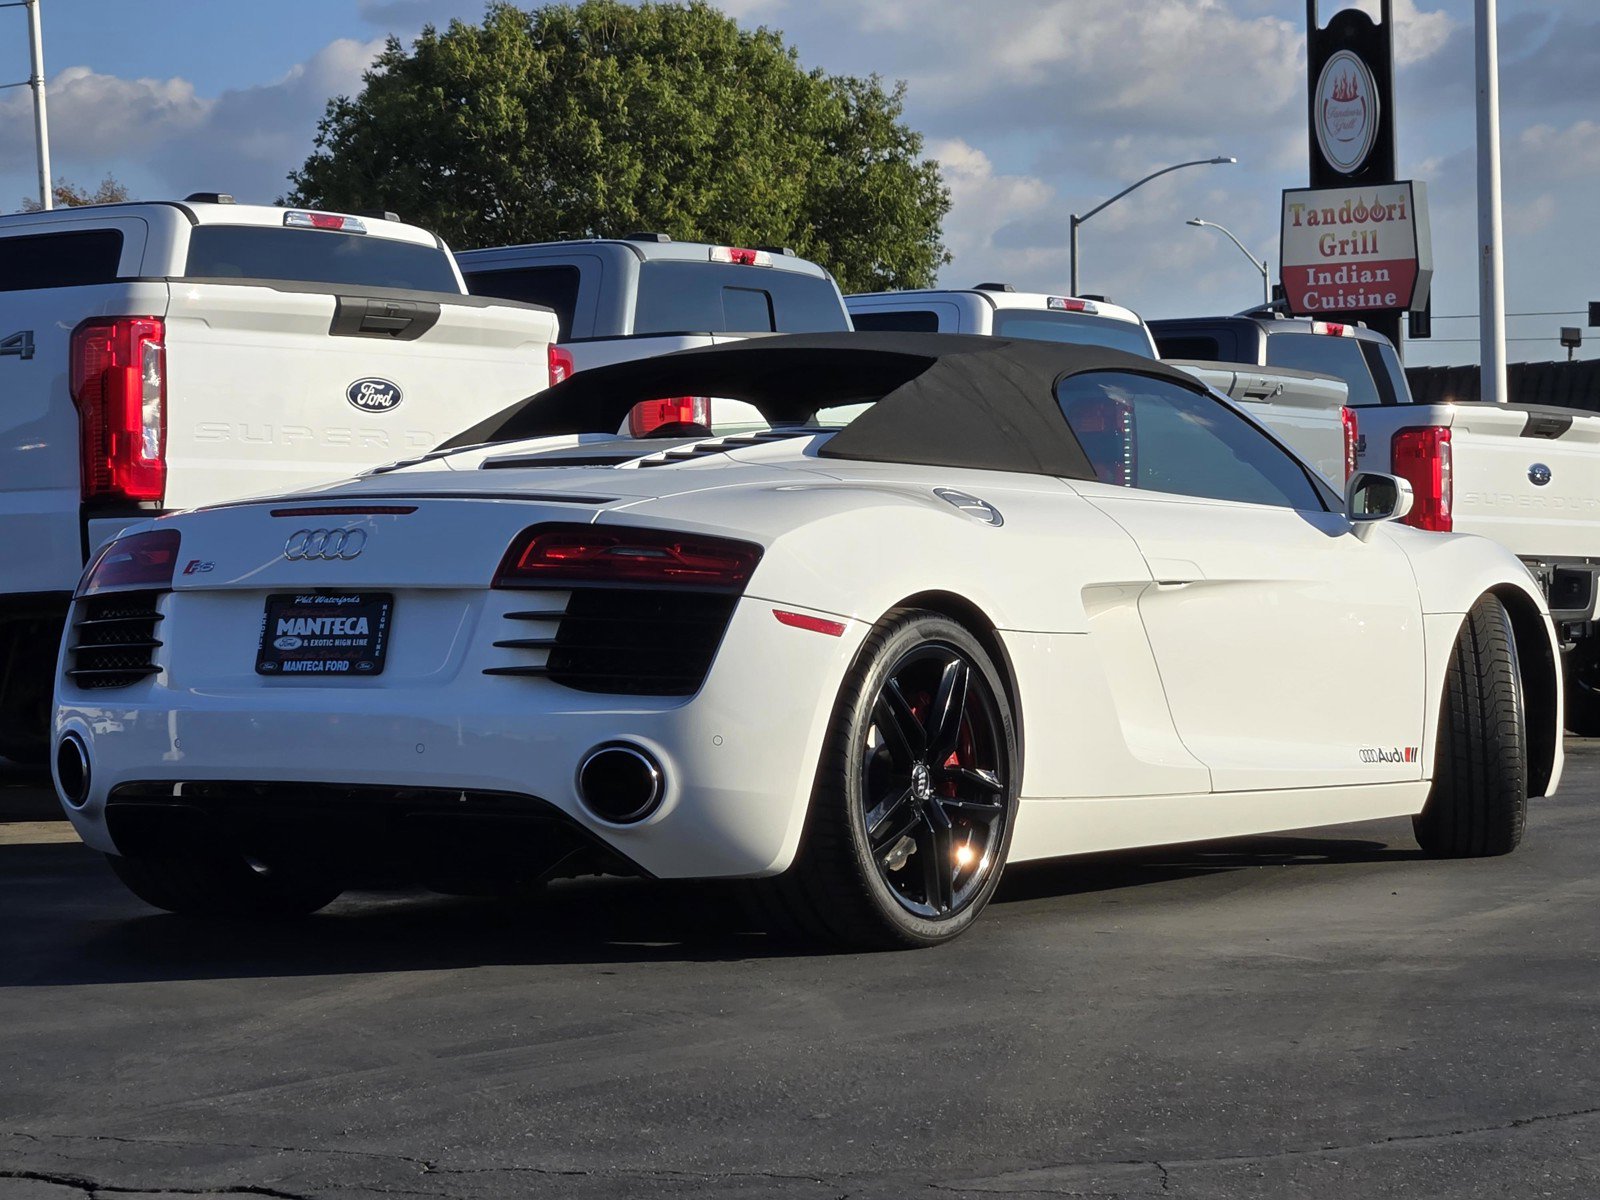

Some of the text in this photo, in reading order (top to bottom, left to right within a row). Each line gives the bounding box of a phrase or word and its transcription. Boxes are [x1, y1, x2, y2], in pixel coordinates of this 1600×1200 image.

[1288, 194, 1407, 227] Tandoori
[1319, 229, 1379, 257] Grill
[1306, 264, 1390, 286] Indian
[1303, 289, 1397, 310] Cuisine
[357, 382, 393, 407] Ford
[192, 421, 390, 449] SUPER
[1463, 492, 1547, 507] SUPER
[183, 559, 215, 575] R8
[295, 595, 313, 604] Phil
[276, 617, 370, 636] MANTECA
[310, 639, 333, 647] EXOTIC
[334, 639, 351, 647] HIGH
[352, 639, 368, 647] LINE
[375, 631, 383, 657] LINE
[282, 660, 350, 672] MANTECA FORD
[1378, 747, 1405, 763] Audi
